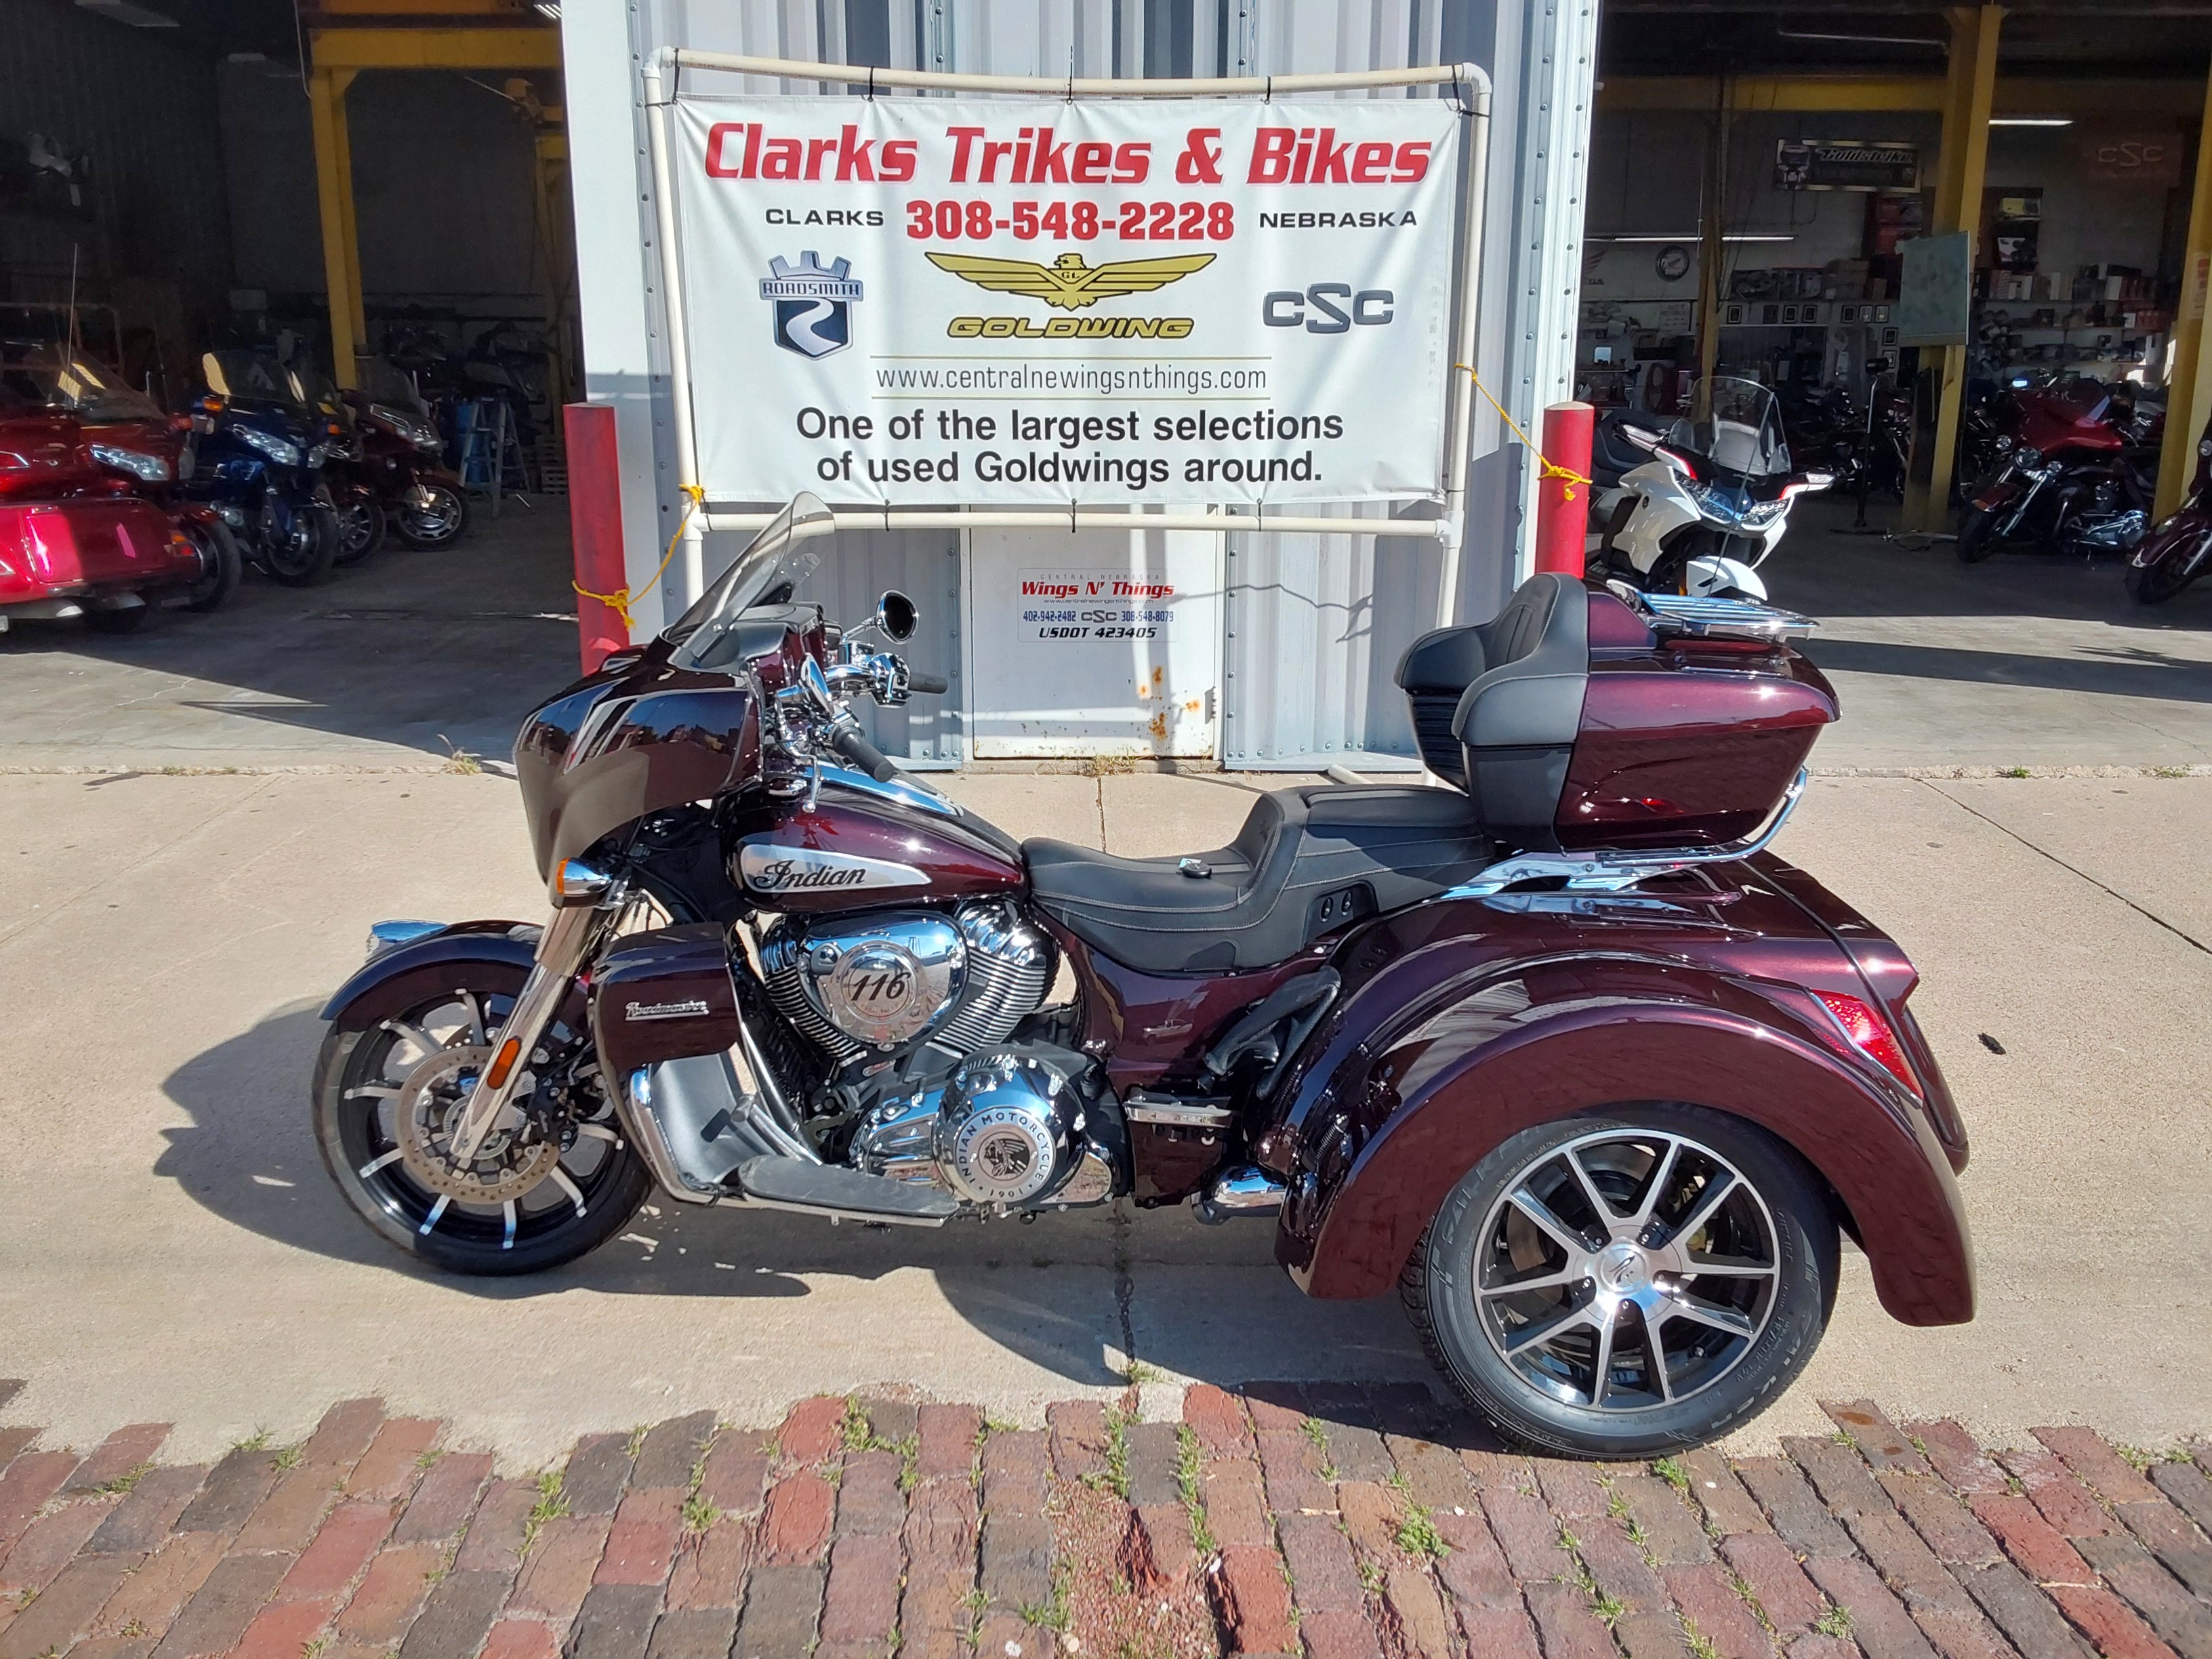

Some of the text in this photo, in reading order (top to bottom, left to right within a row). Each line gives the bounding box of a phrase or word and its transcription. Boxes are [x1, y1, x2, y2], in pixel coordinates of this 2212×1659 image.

[705, 123, 1433, 184] Clarks Trikes & Bikes
[766, 209, 884, 226] CLARKS
[906, 200, 1234, 241] 308-548-2228
[1259, 211, 1418, 228] NEBRASKA
[762, 282, 860, 295] ROADSMITH
[947, 317, 1194, 338] GOLDWING
[876, 363, 1267, 394] www.centralnewingsnthings.com
[796, 407, 1343, 449] One of the largest selections
[817, 450, 1322, 491] of used Goldwings around.
[1022, 581, 1175, 599] Wings N' Things
[1039, 627, 1158, 638] USDOT 423405
[754, 859, 867, 890] Indian
[851, 972, 912, 1002] 116
[957, 1112, 1050, 1185] INDIAN MOTORCYCLE
[989, 1187, 1024, 1198] 1901
